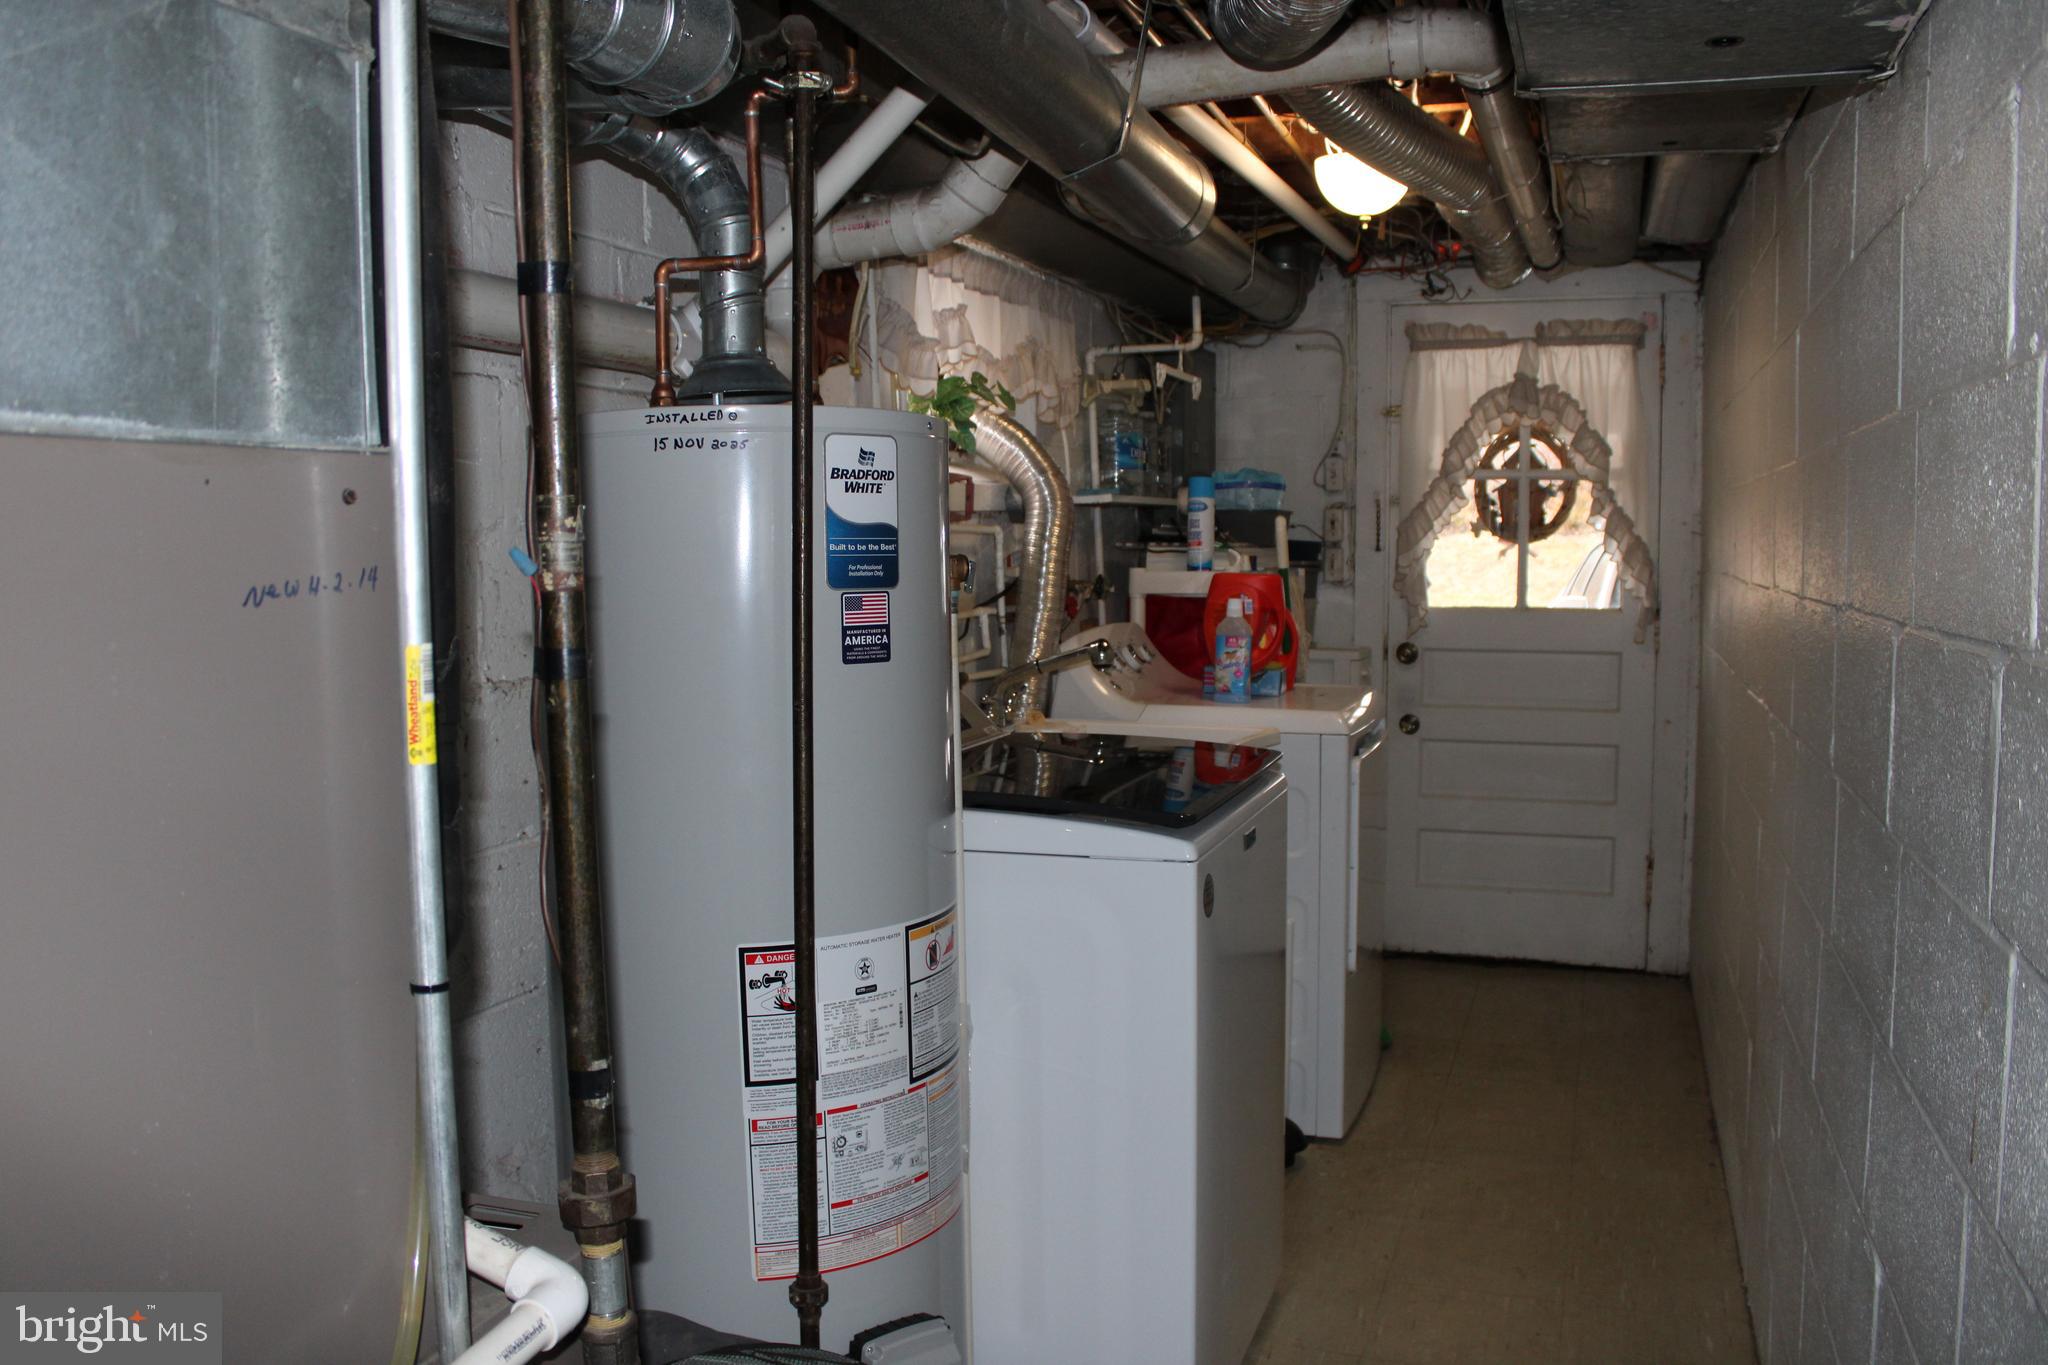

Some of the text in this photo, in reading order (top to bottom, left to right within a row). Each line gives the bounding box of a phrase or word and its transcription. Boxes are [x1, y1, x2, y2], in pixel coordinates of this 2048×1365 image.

[644, 409, 724, 425] INSTALLED
[654, 437, 749, 452] 15 NOV 2025
[830, 467, 895, 481] BRADFORD
[844, 481, 883, 494] WHITE
[829, 543, 847, 551] Built
[857, 543, 867, 551] be
[868, 543, 879, 551] the
[844, 634, 889, 646] AMERICA
[766, 953, 796, 962] DANGE
